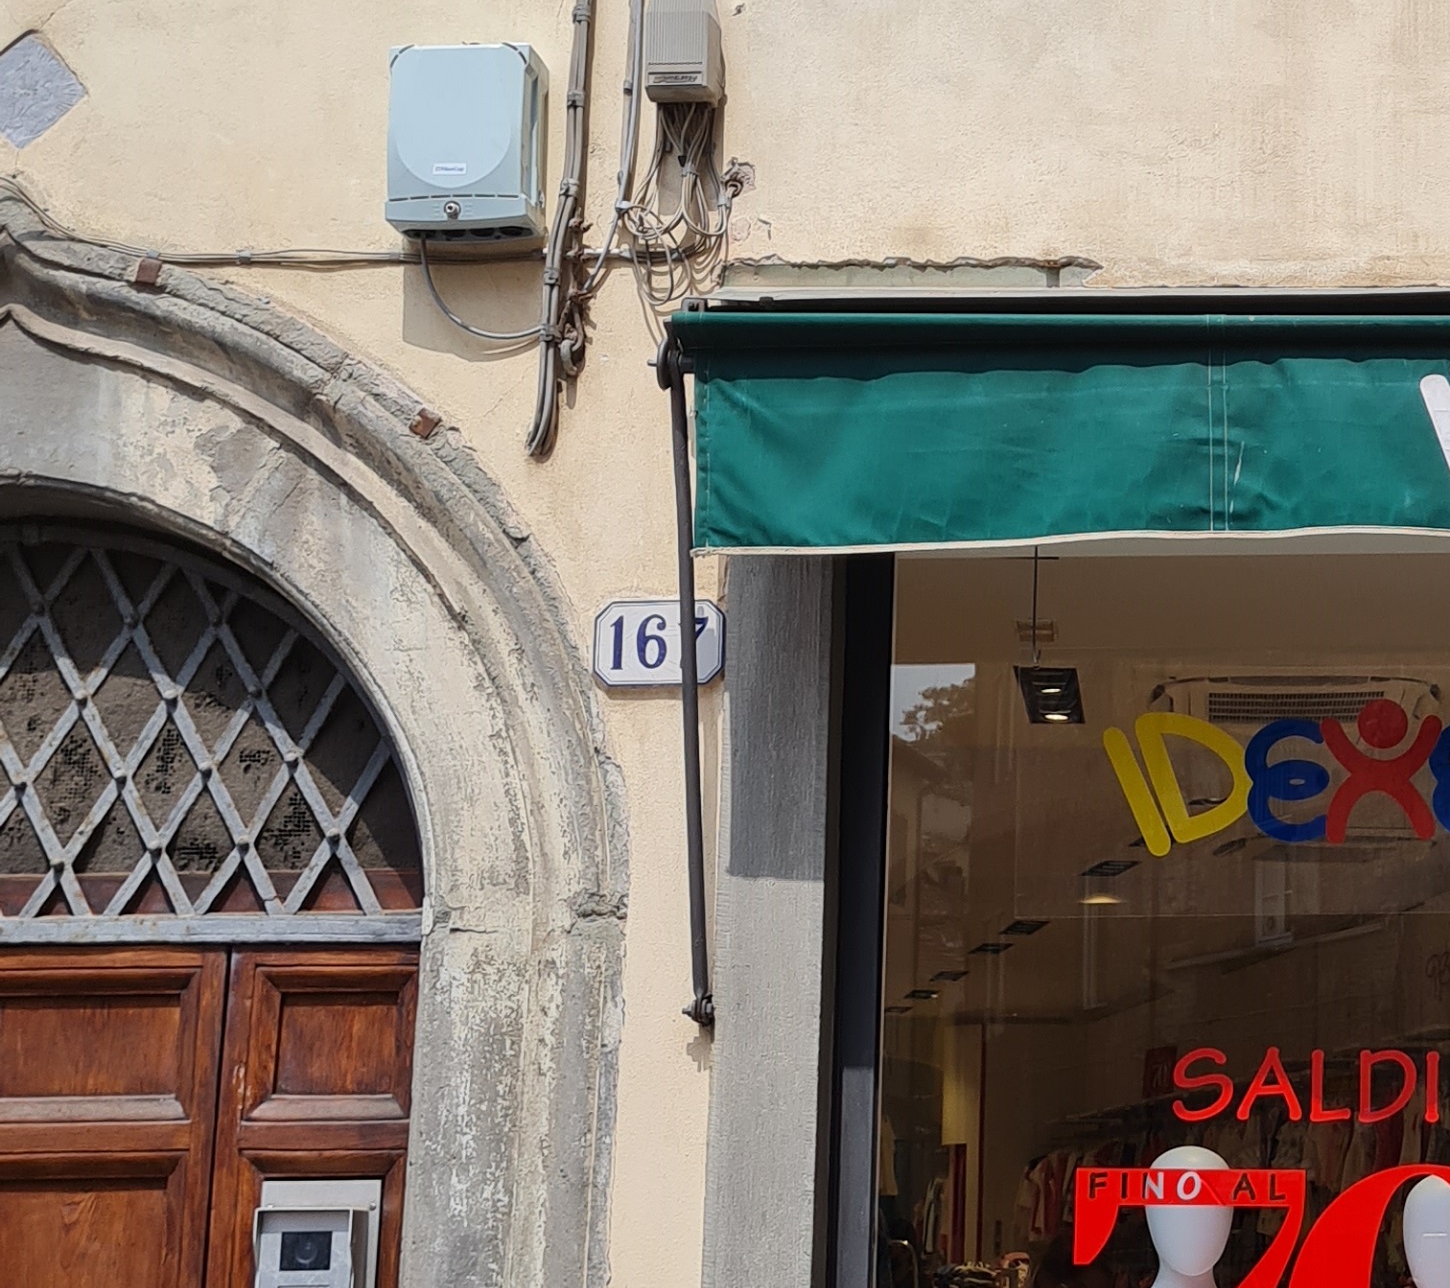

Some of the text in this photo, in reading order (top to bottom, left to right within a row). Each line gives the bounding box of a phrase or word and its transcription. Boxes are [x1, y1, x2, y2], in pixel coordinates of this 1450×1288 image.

[1172, 1047, 1440, 1124] SALDI
[1088, 1170, 1287, 1201] FINO AL
